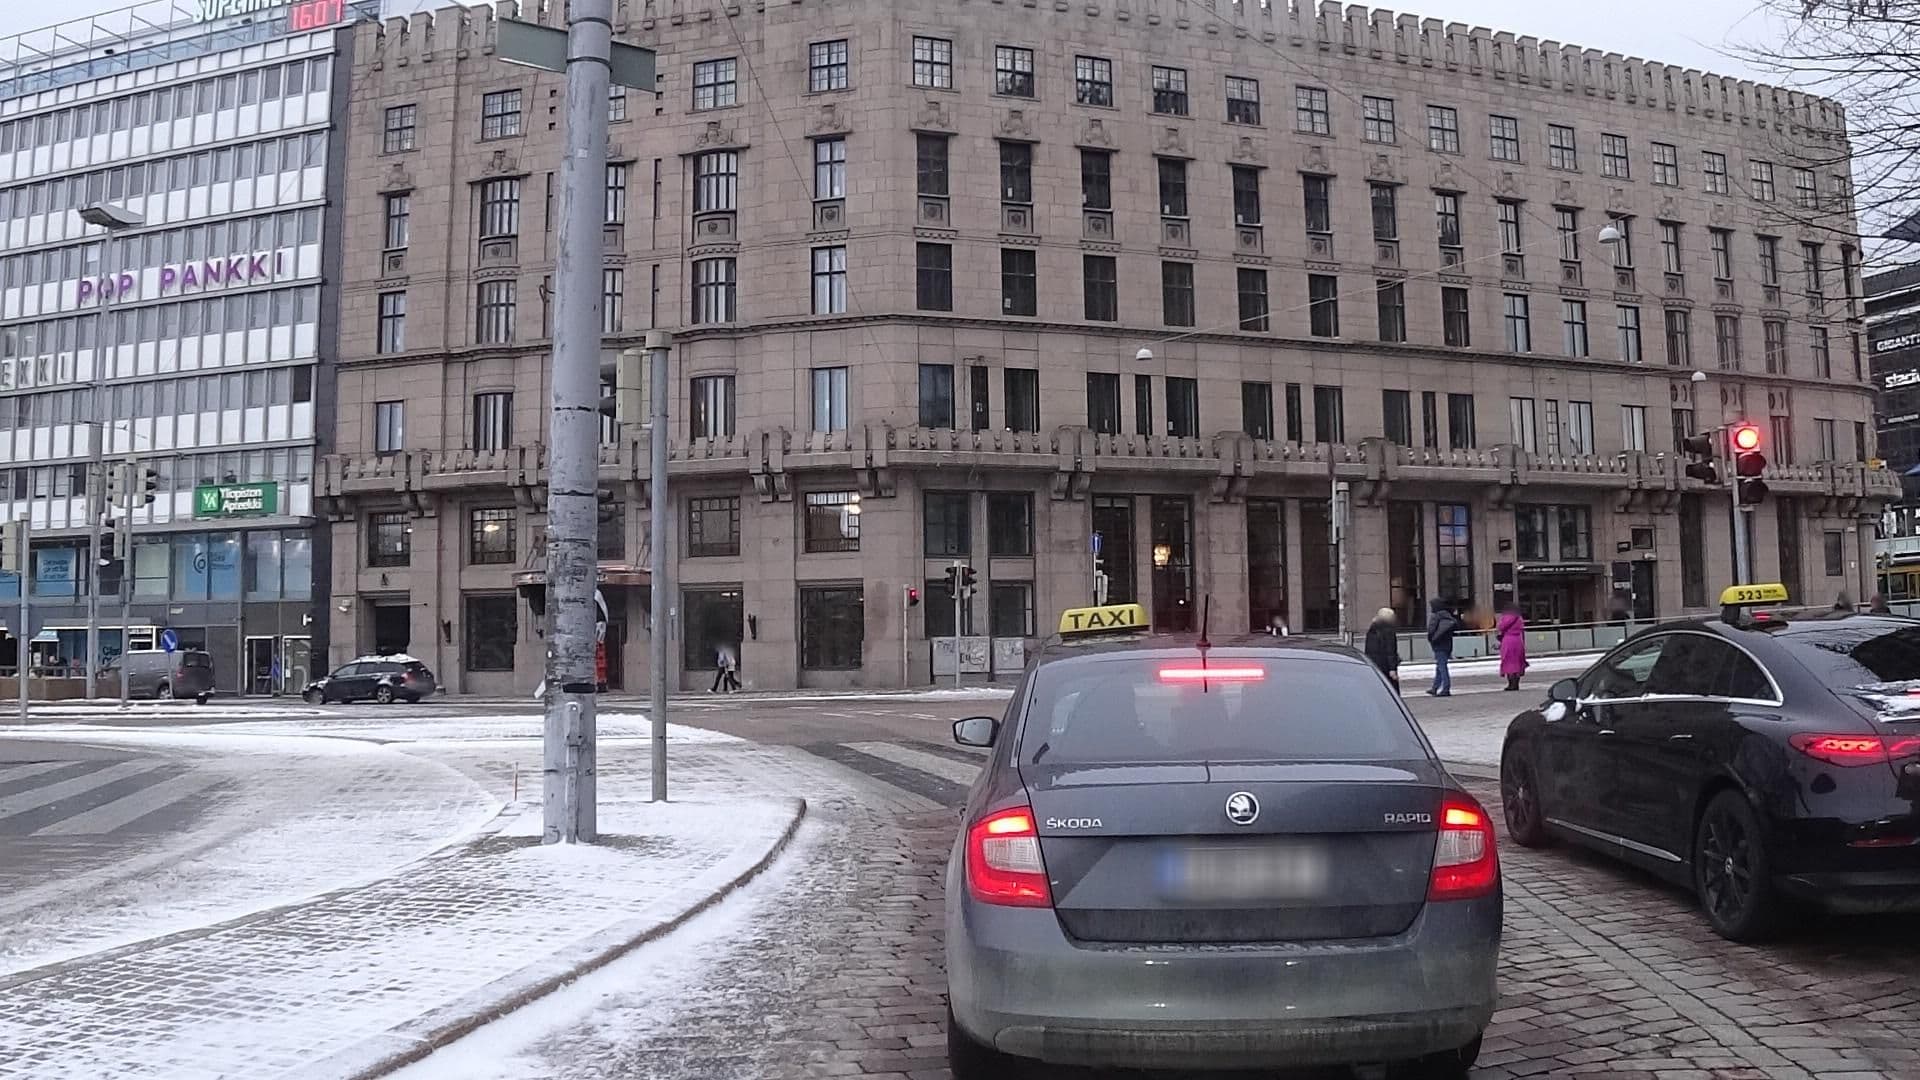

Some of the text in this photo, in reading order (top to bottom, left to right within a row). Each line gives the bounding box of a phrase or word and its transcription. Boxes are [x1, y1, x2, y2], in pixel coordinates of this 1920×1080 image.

[79, 252, 283, 302] POP PANKKI
[1738, 590, 1762, 601] 523
[1067, 609, 1135, 629] TAXI
[1046, 817, 1103, 829] ŠKODA
[1384, 813, 1432, 823] RAPID
